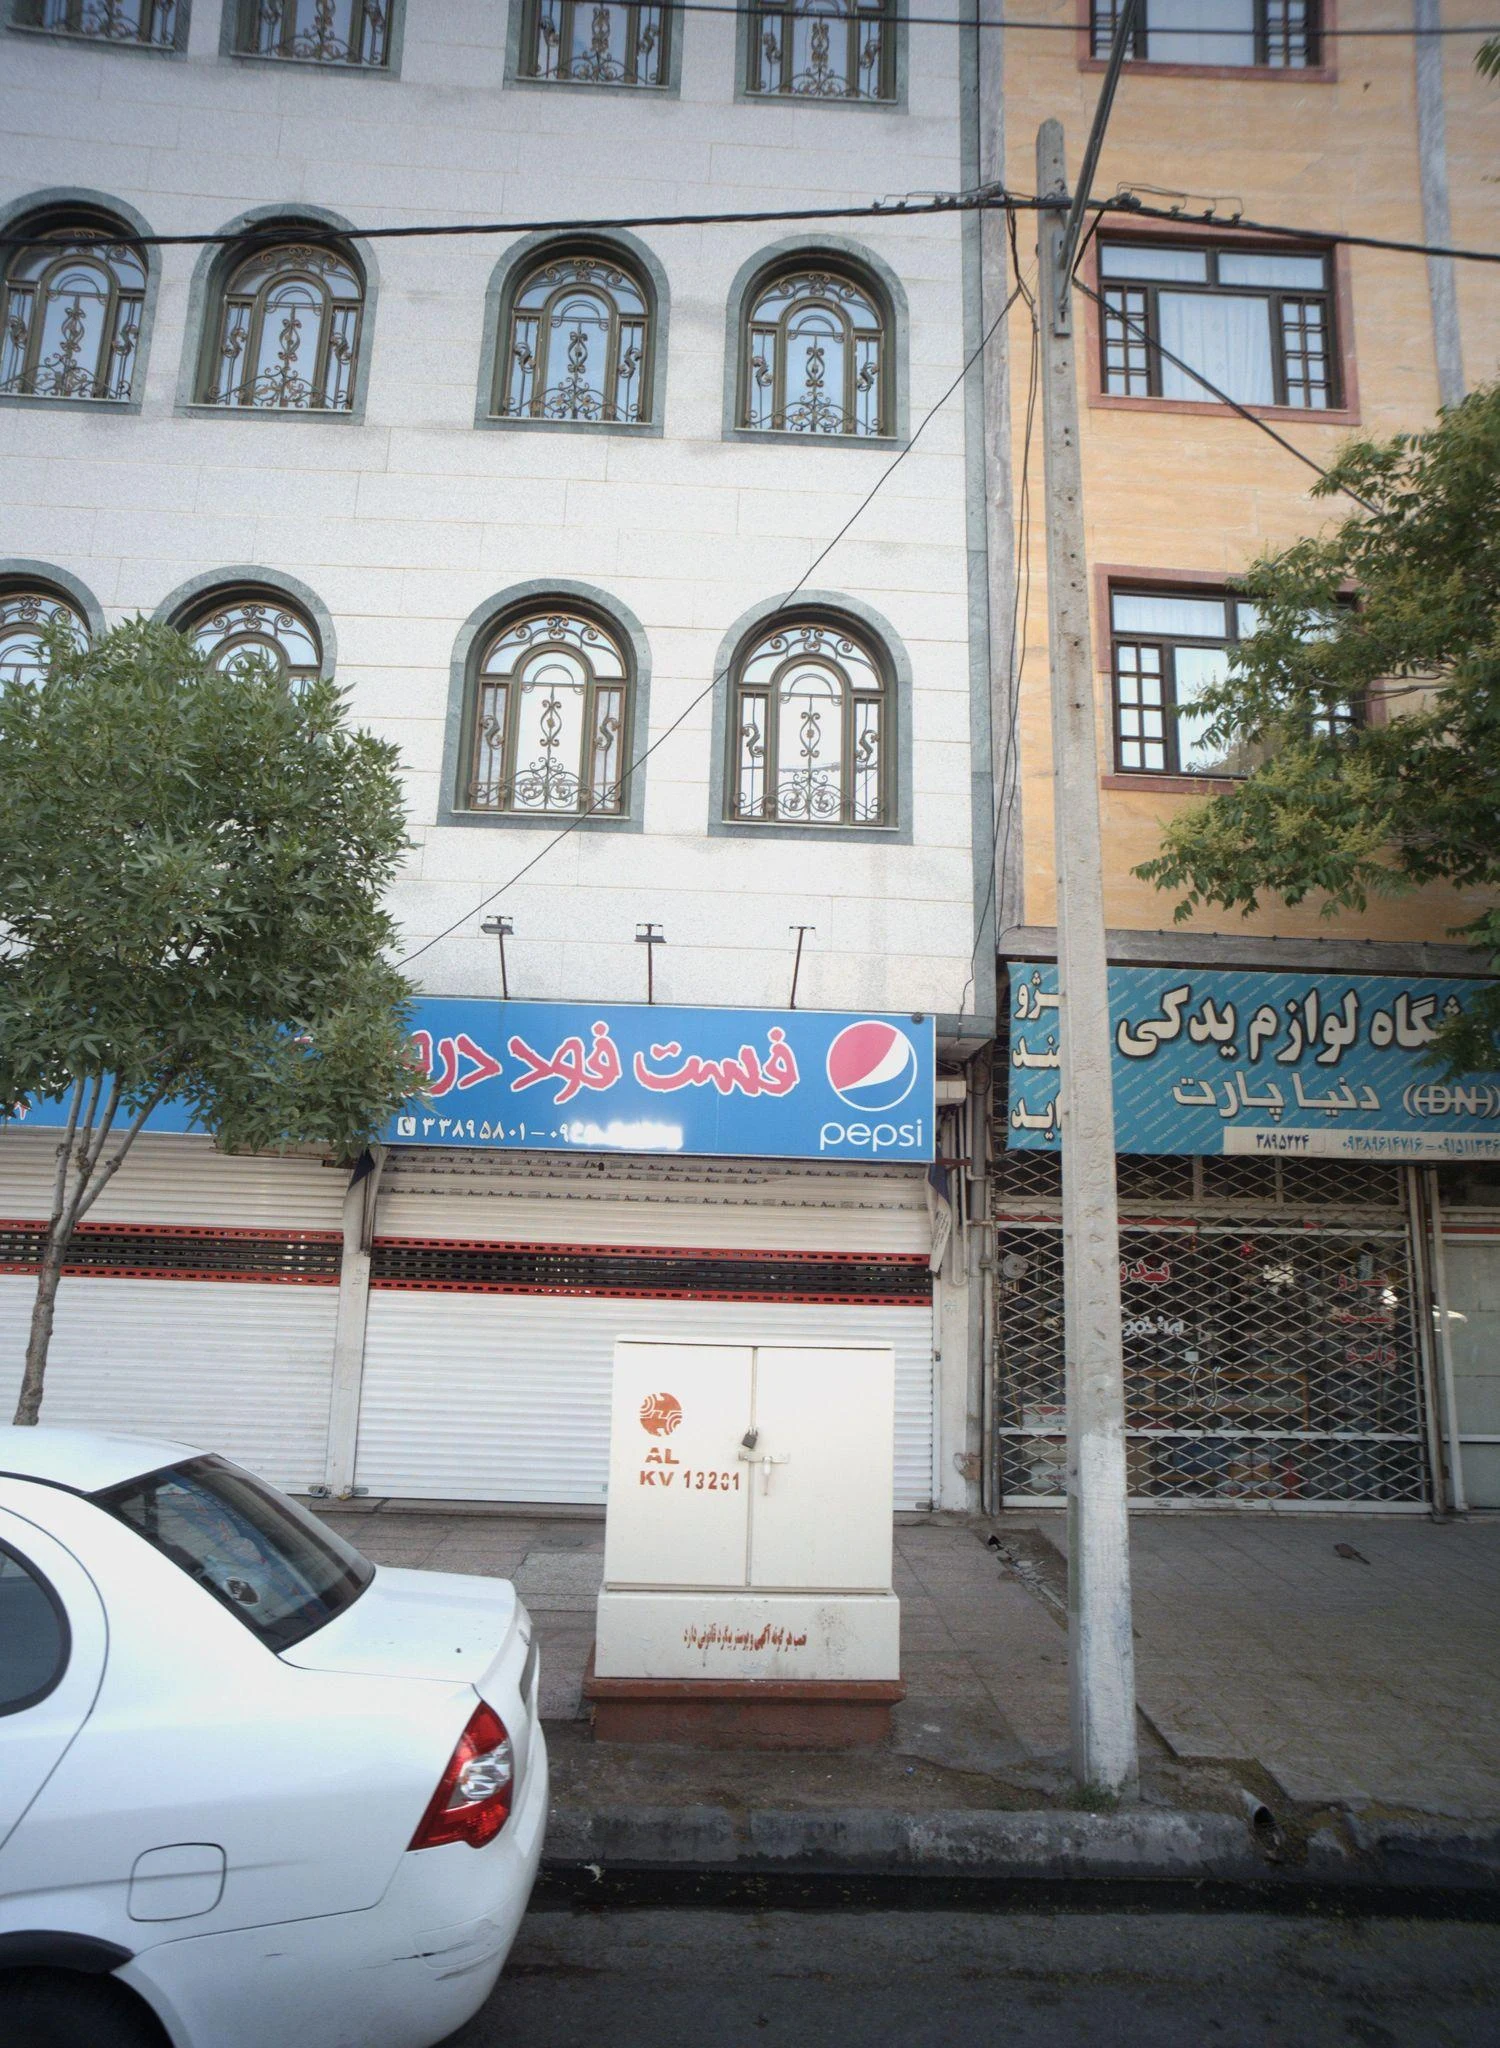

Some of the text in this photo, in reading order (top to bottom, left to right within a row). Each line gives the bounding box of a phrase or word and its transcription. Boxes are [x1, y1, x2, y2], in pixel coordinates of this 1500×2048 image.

[1116, 984, 1236, 1058] یدکی
[1249, 988, 1361, 1064] لوازم
[508, 1021, 623, 1104] فود
[634, 1027, 800, 1097] فست
[1171, 1070, 1286, 1122] پارت
[1291, 1072, 1381, 1118] دنیا
[422, 1117, 525, 1141] ۳۳۸۹۵۸۰۱
[820, 1119, 922, 1152] pepsi
[640, 1470, 740, 1490] KV 13201
[645, 1447, 680, 1464] AL
